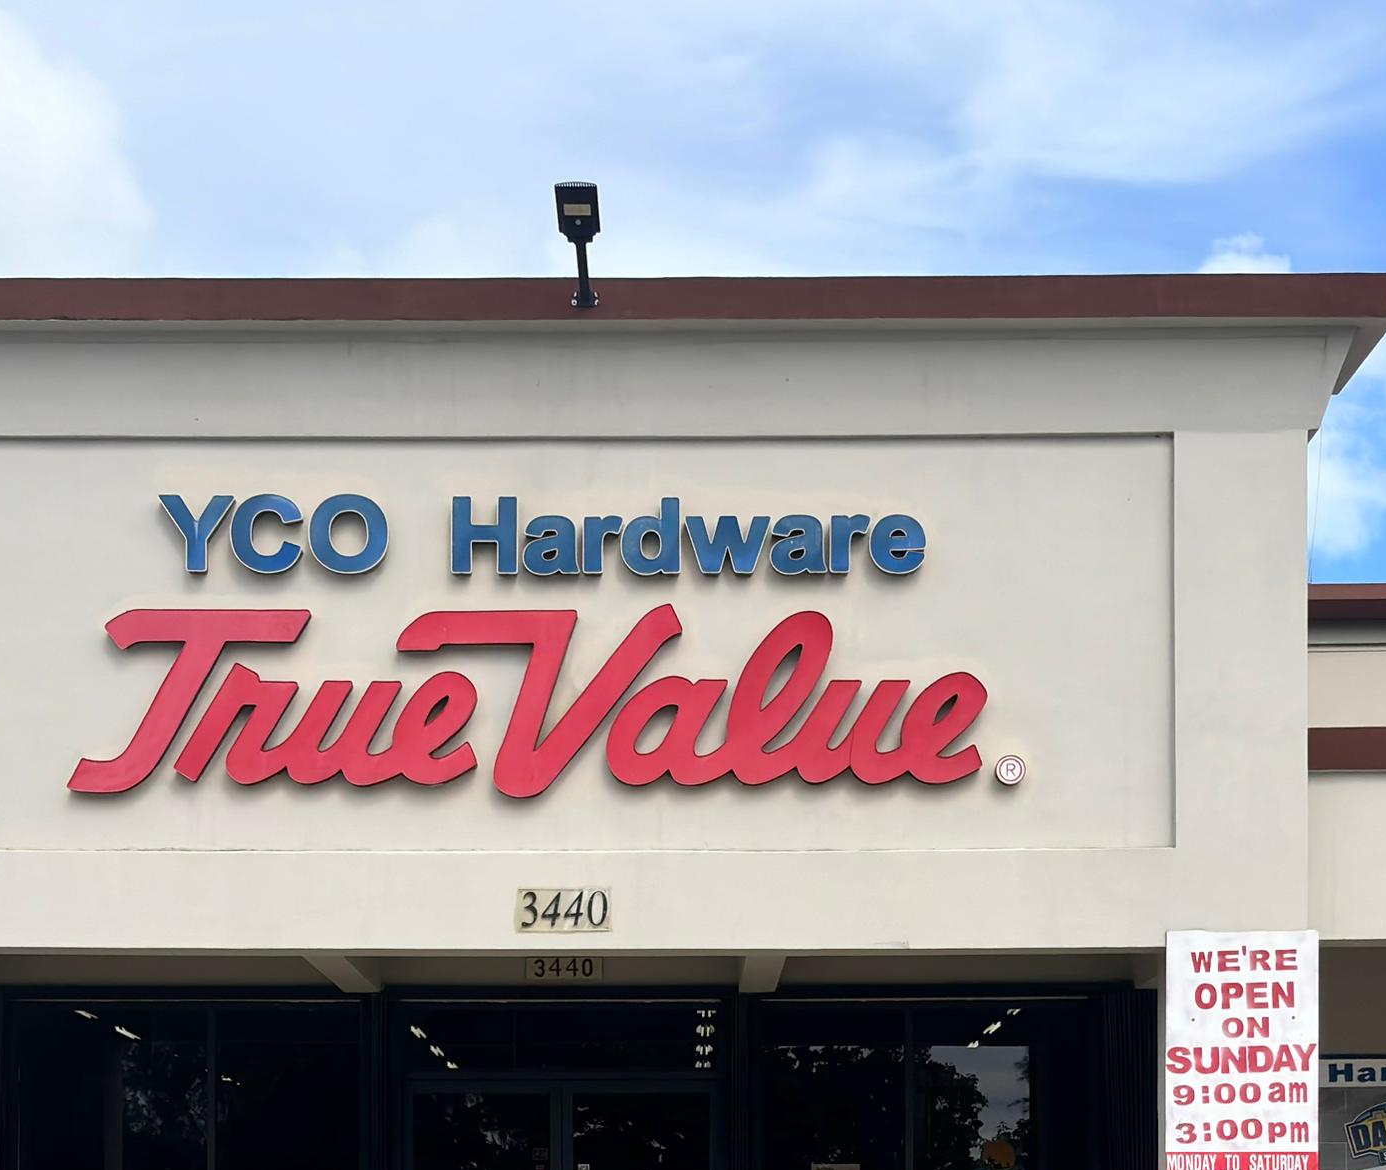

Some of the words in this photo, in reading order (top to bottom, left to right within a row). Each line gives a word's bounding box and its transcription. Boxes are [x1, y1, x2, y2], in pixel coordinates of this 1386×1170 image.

[159, 493, 389, 575] YCO
[450, 496, 926, 576] Hardware
[67, 608, 479, 795] True
[395, 603, 989, 798] Value
[520, 890, 608, 928] 3440
[533, 956, 594, 978] 3440
[1190, 945, 1299, 974] WE'RE
[1194, 981, 1295, 1010] OPEN
[1221, 1016, 1270, 1039] ON
[1164, 1043, 1318, 1075] SUNDAY
